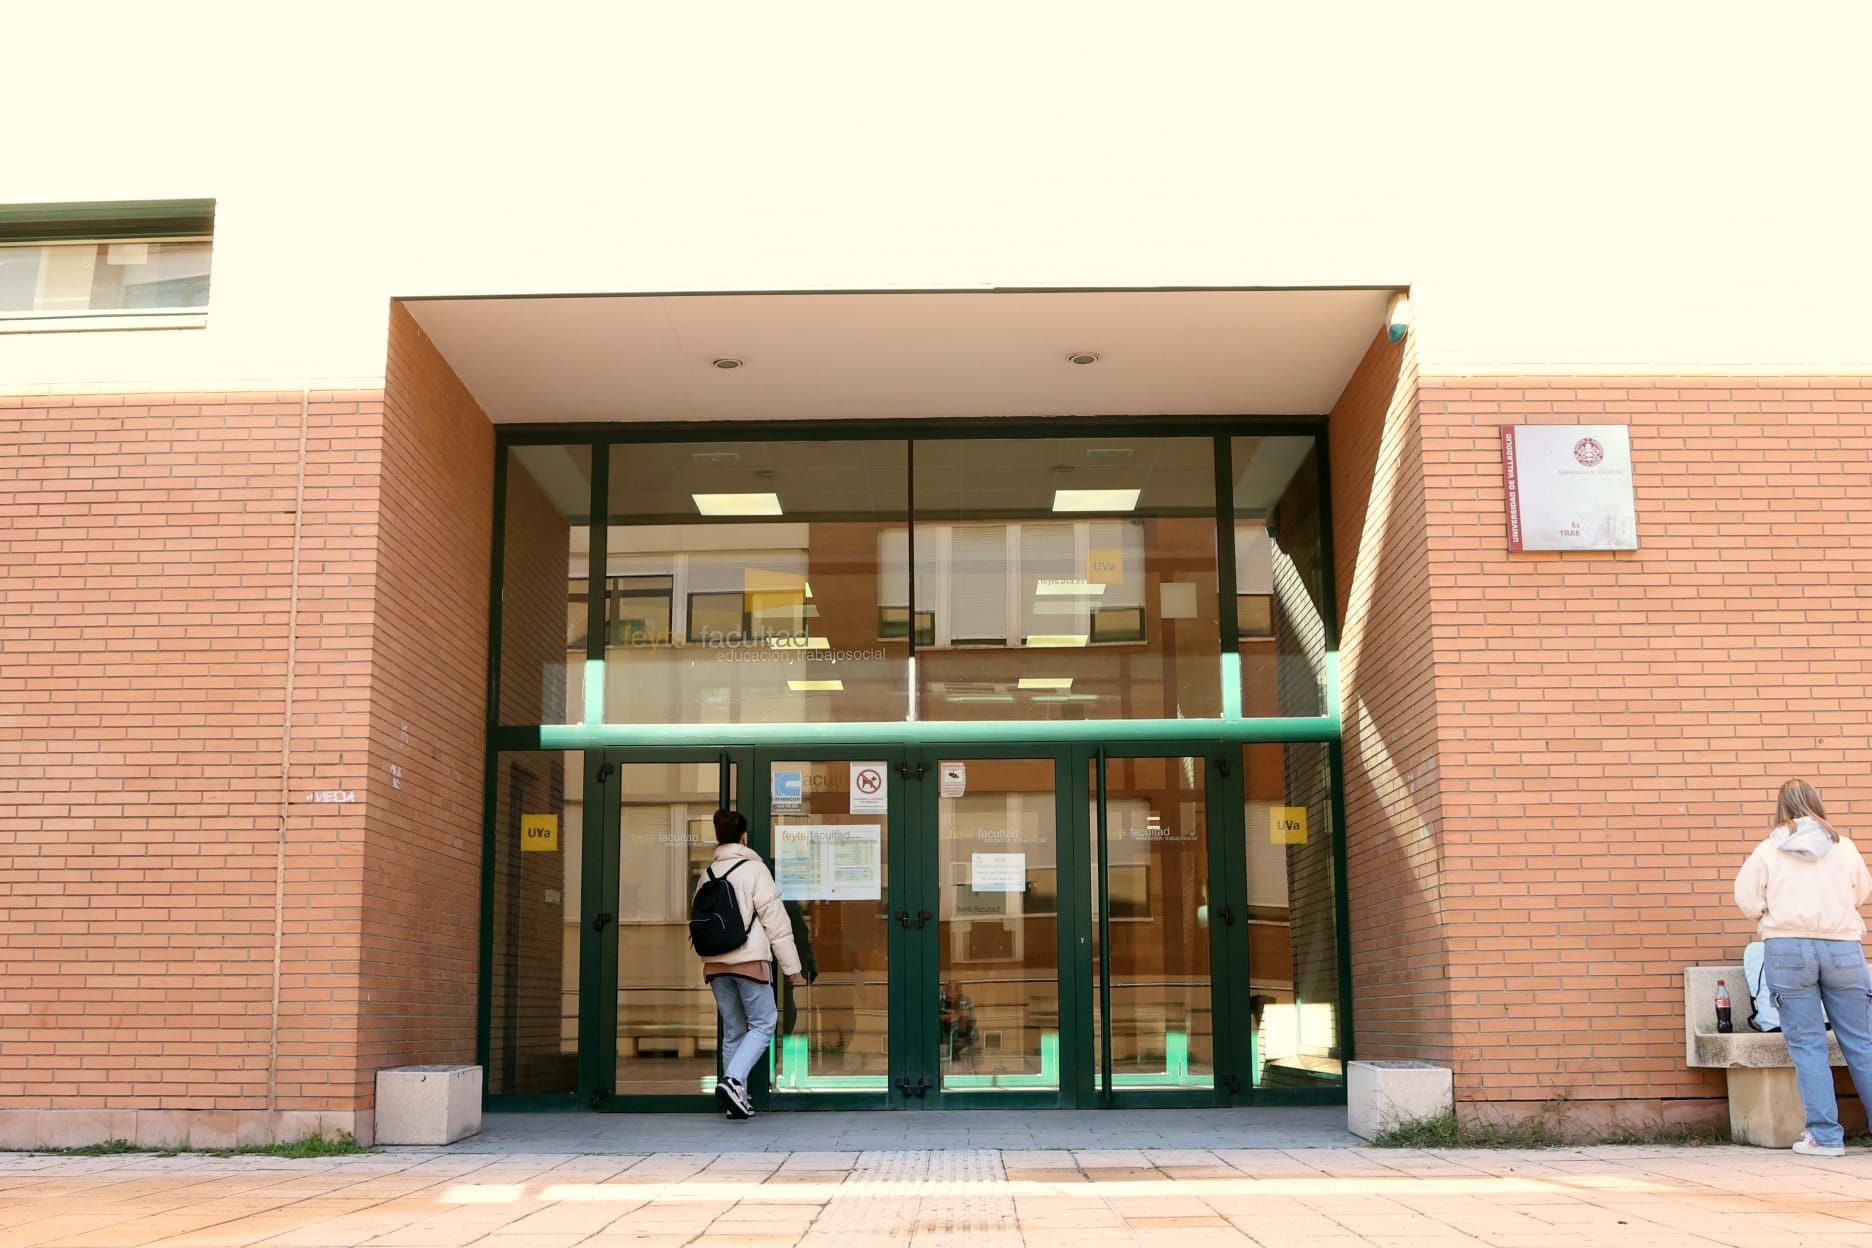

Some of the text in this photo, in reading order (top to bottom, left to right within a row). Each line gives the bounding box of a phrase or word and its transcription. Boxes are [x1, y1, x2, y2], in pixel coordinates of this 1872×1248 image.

[1505, 433, 1519, 543] UNIVERSIDAD DE VALLADOLID
[1093, 561, 1116, 572] UVa
[699, 623, 809, 649] facultad
[797, 647, 887, 664] trabajosocial
[1276, 819, 1300, 831] UVa
[527, 827, 551, 839] UVa
[658, 831, 699, 842] facultad
[1130, 826, 1170, 837] facultad
